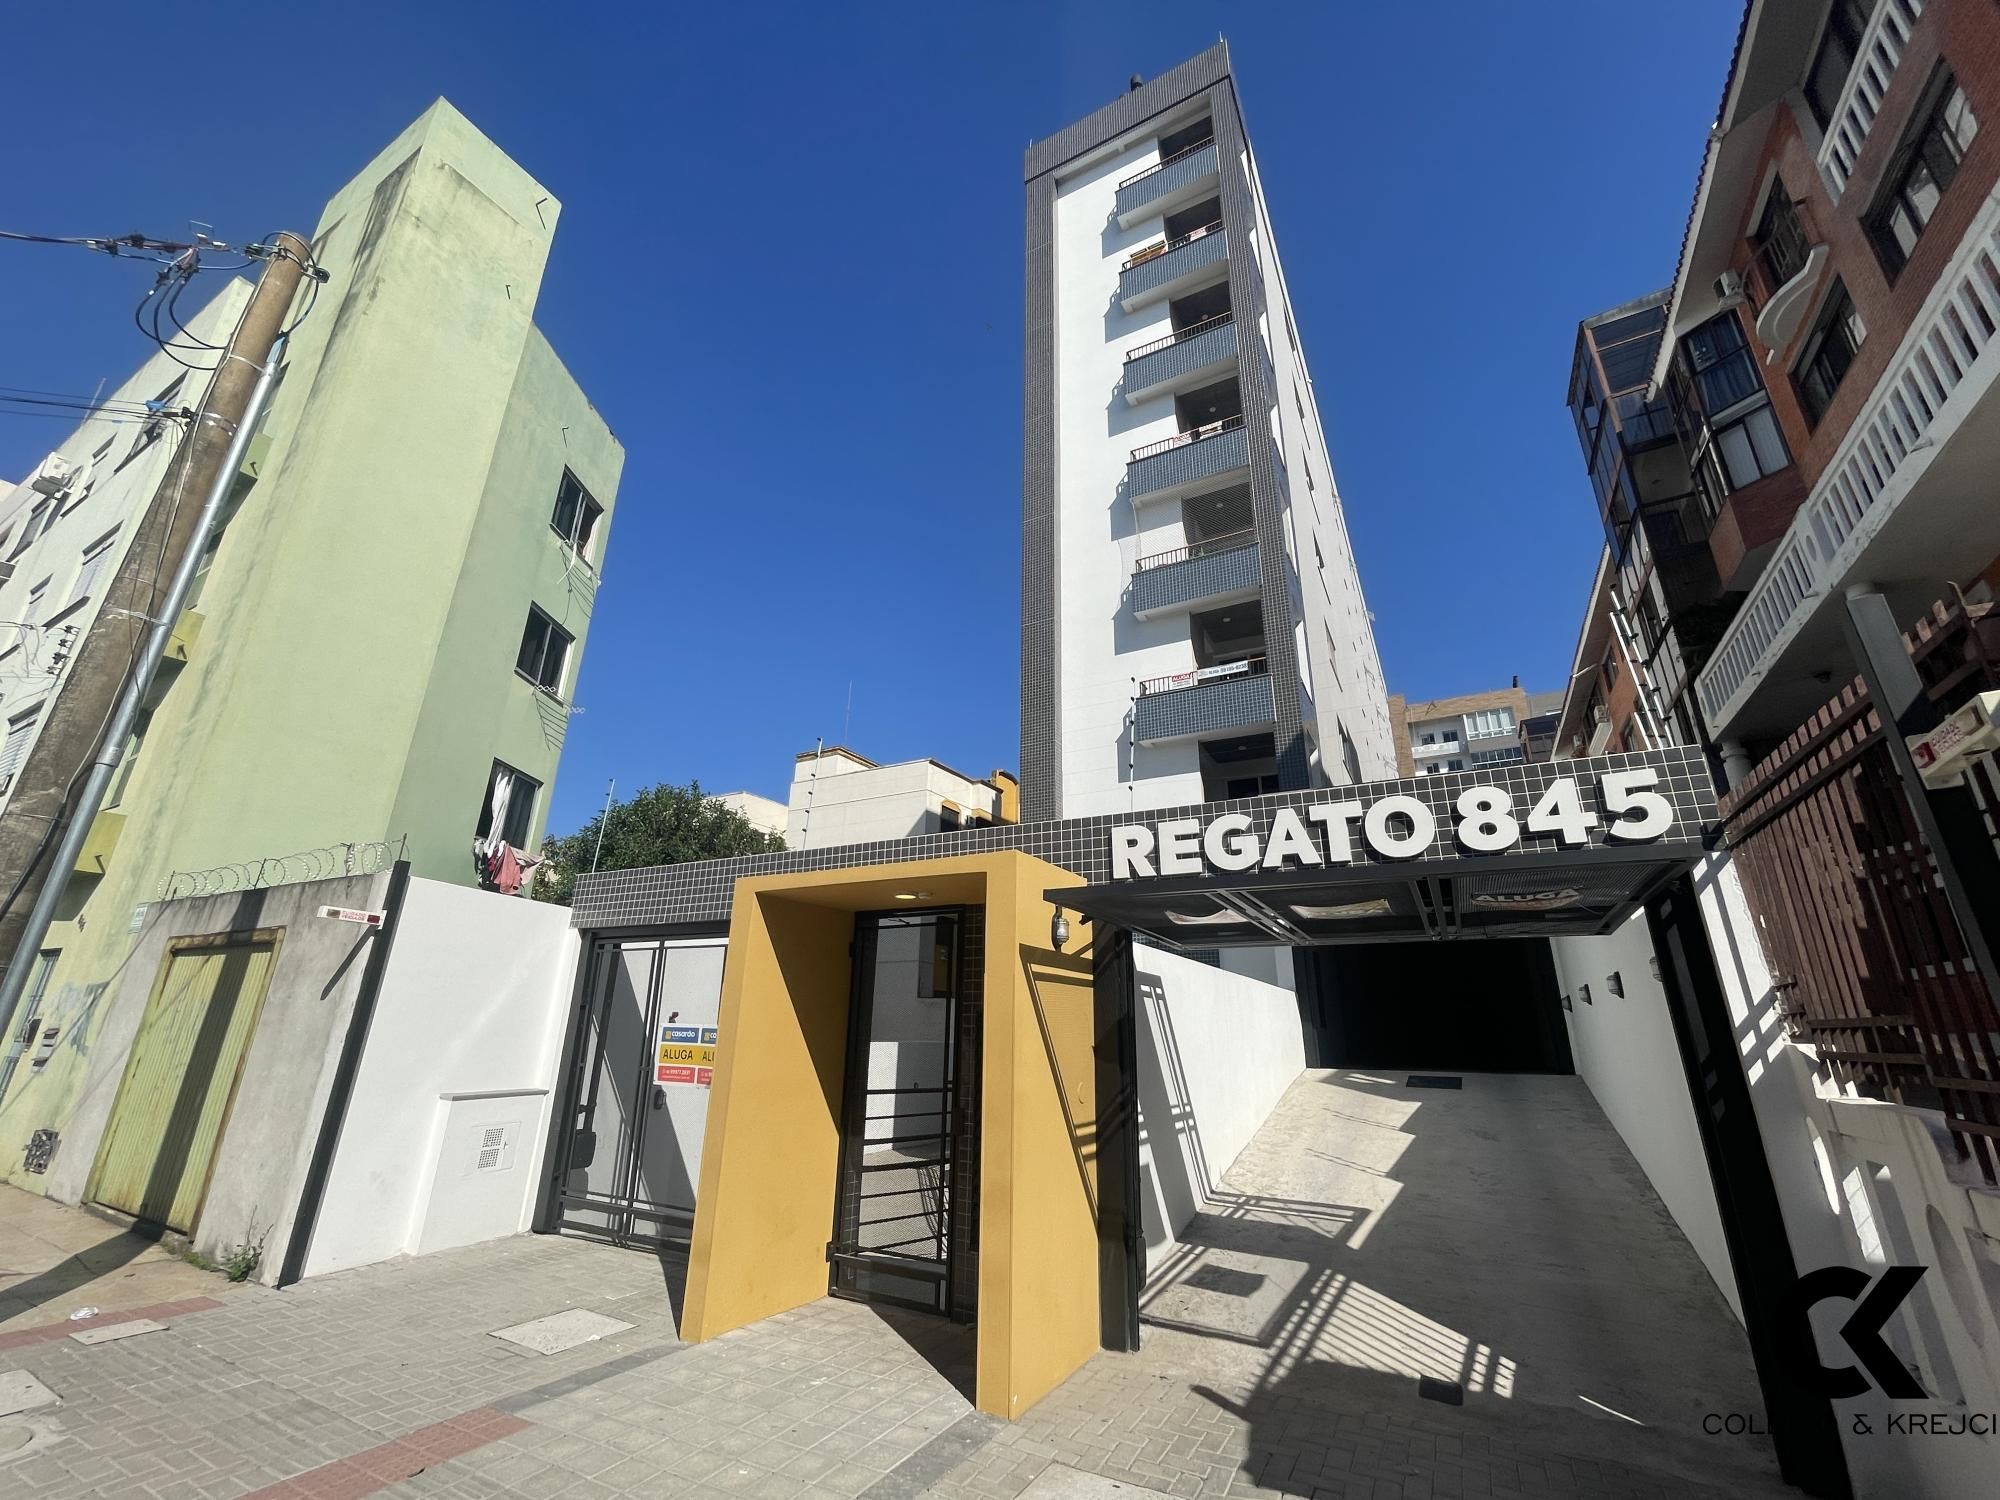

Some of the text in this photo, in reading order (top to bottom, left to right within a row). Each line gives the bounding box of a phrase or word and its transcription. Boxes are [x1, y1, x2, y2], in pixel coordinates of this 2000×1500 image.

[1172, 672, 1192, 682] ALUGA
[1111, 768, 1675, 881] REGATO 845
[1474, 888, 1580, 902] ALUGA
[662, 1049, 693, 1060] ALUGA
